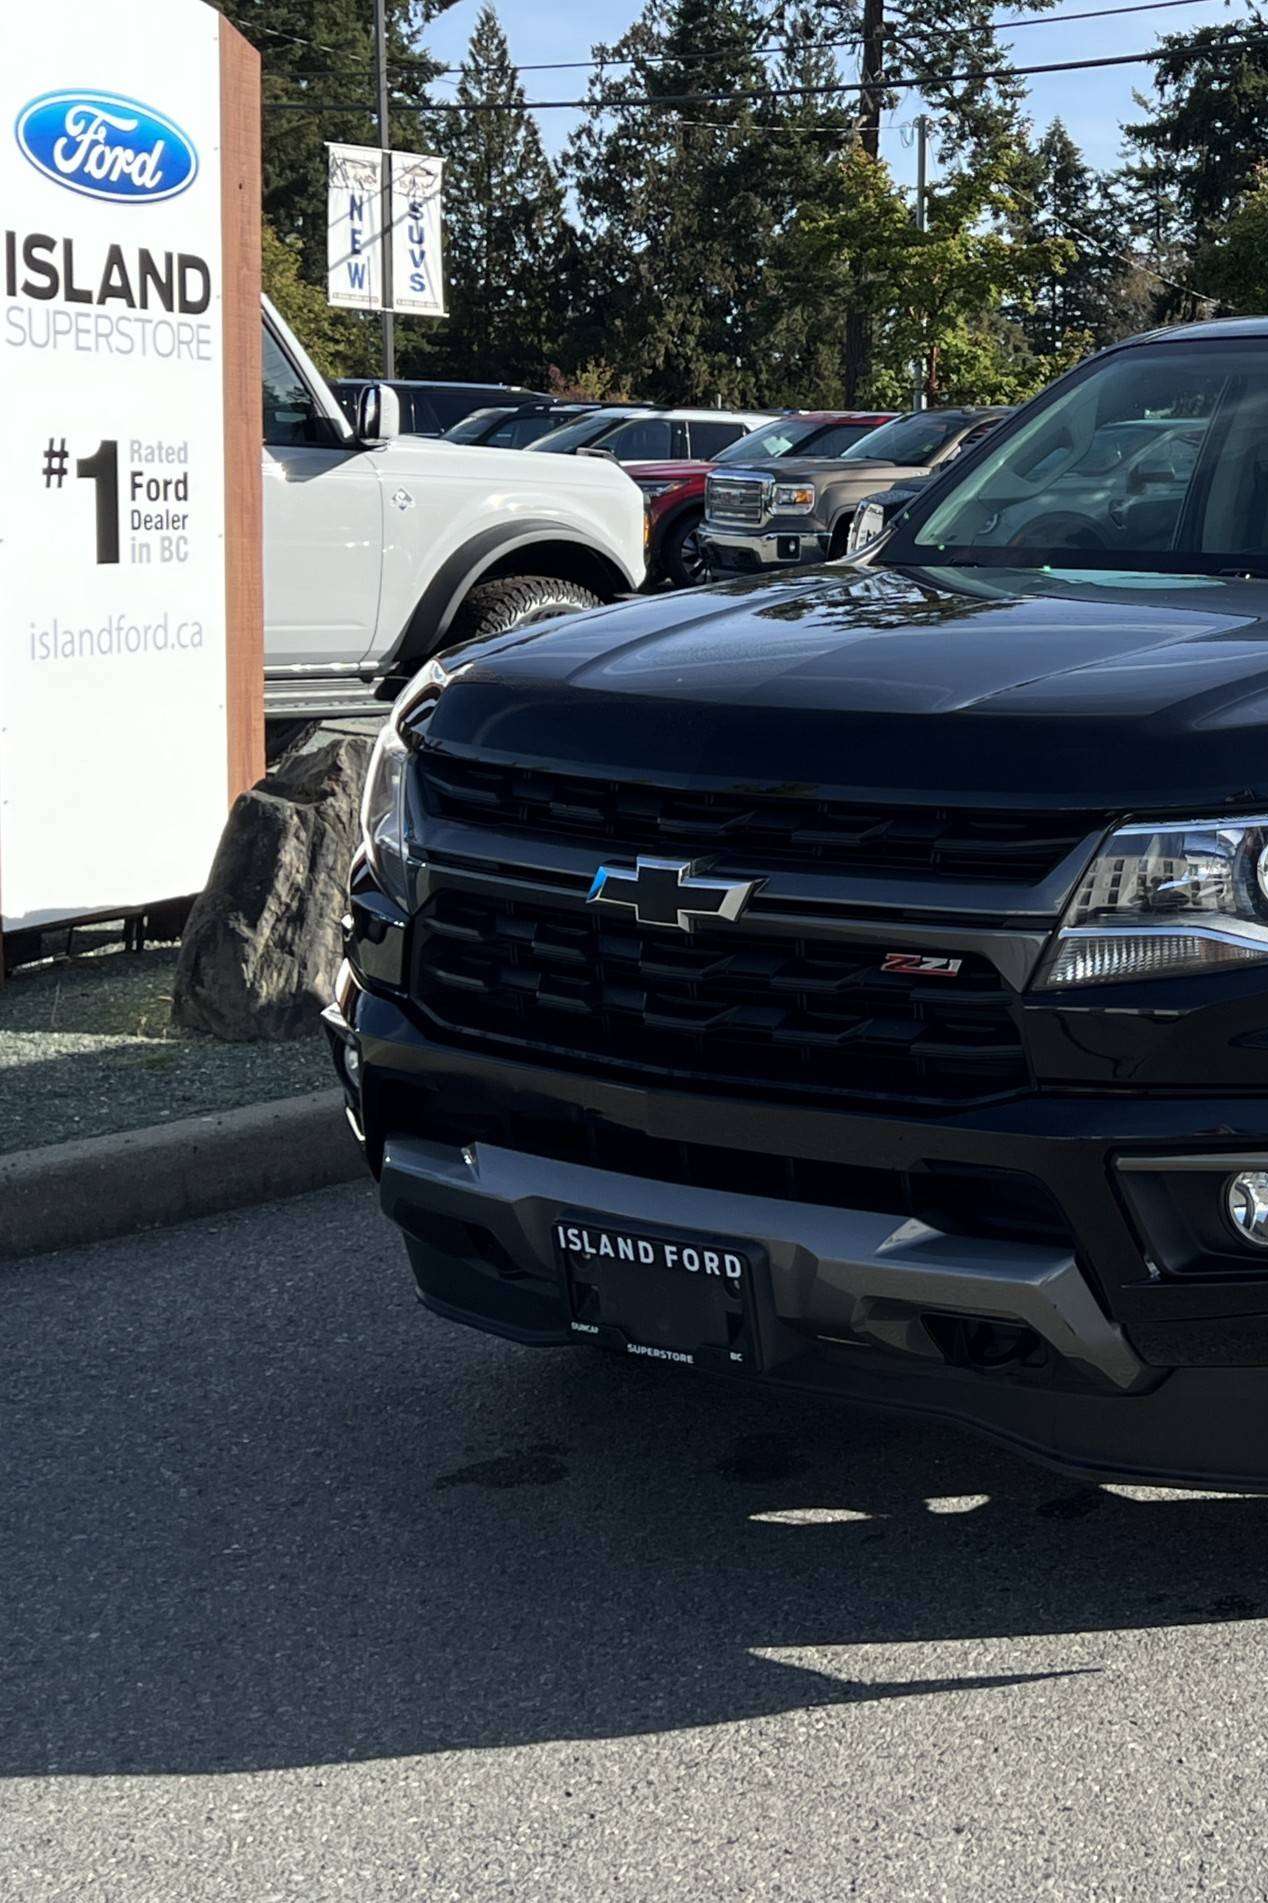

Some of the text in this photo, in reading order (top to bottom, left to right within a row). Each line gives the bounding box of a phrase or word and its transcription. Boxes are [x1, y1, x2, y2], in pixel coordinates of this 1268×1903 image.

[53, 105, 165, 188] Ford
[347, 194, 366, 290] NEW
[408, 201, 426, 292] SUVS
[5, 230, 211, 315] ISLAND
[5, 305, 212, 361] SUPERSTORE
[130, 439, 189, 464] Rated
[43, 438, 120, 564] #1
[130, 470, 189, 502] Ford
[130, 508, 189, 531] Dealer
[131, 535, 189, 564] in BC
[30, 611, 203, 661] islandford.ca
[881, 952, 962, 977] Z71
[557, 1225, 742, 1279] ISLAND FORD
[627, 1343, 695, 1364] SUPERSTORE
[729, 1351, 743, 1363] BC
